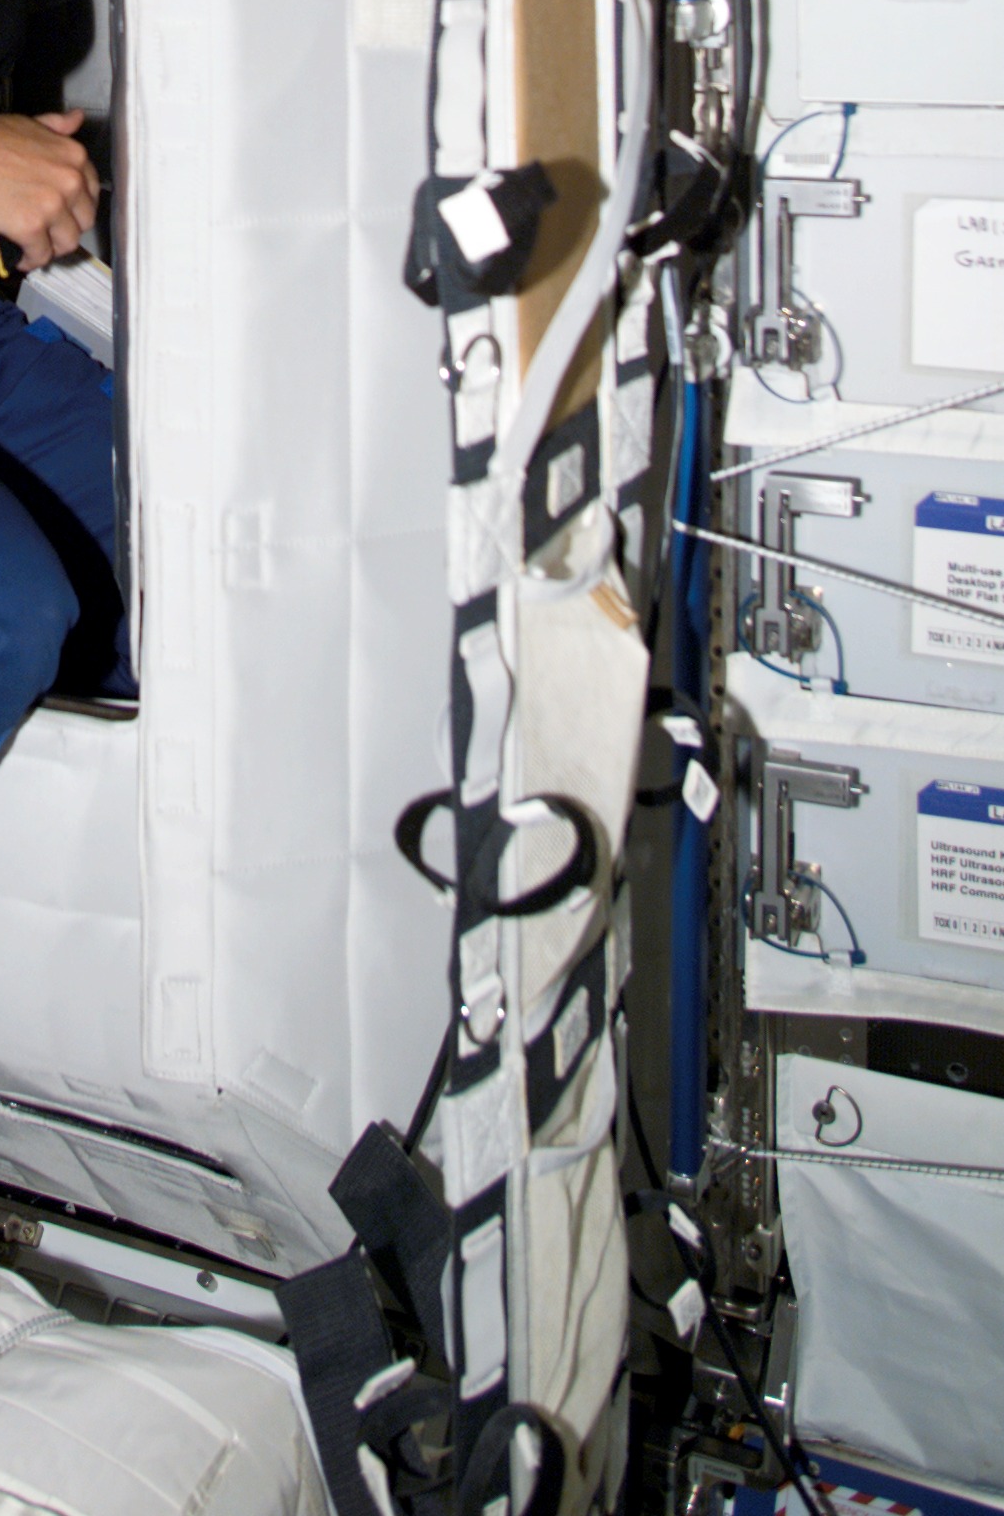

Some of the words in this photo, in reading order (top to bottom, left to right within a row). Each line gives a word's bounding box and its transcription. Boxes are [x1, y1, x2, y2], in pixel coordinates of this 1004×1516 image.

[948, 561, 1002, 577] Multi-use
[947, 573, 996, 590] Desktop
[947, 586, 972, 599] HRF
[930, 840, 996, 859] Ultrasound
[930, 854, 955, 866] HRF
[930, 867, 955, 879] HRF
[930, 880, 955, 893] HRF
